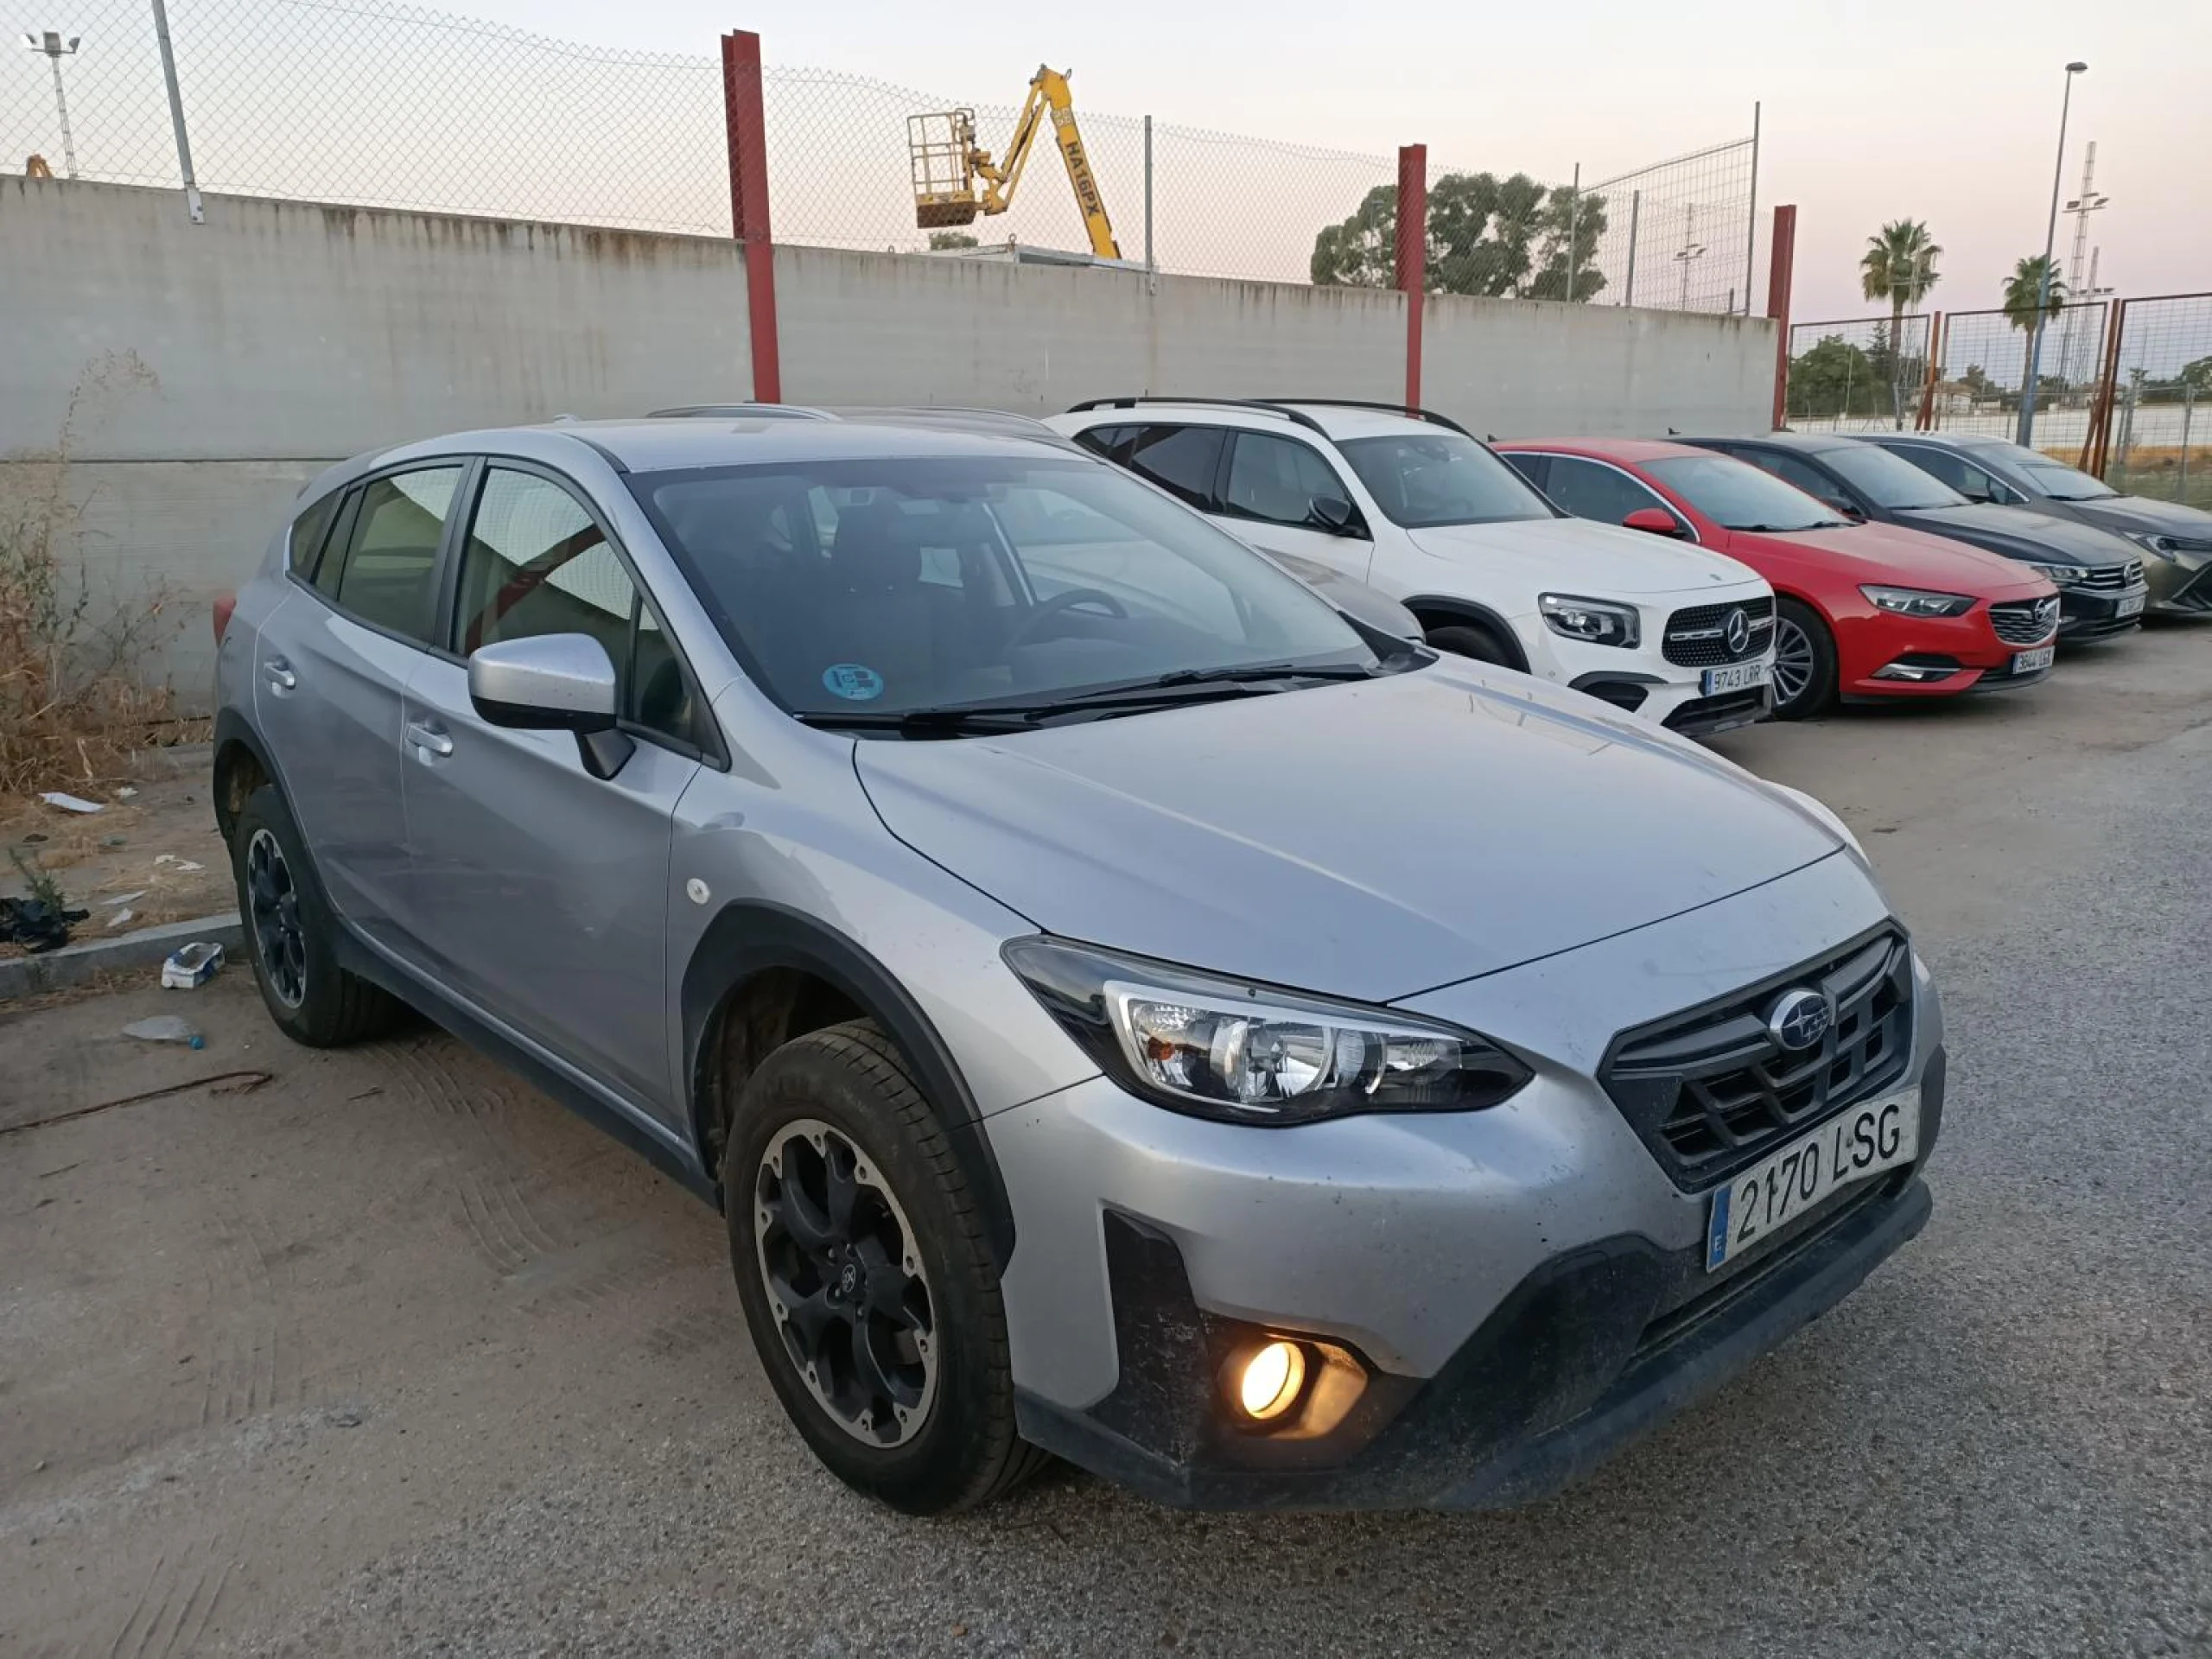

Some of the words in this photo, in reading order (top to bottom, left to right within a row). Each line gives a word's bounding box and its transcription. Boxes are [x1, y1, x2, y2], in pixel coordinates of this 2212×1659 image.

[1066, 142, 1101, 216] HA16PX
[1715, 669, 1740, 690] 9743
[1737, 1142, 1819, 1243] 2170
[1833, 1104, 1899, 1183] LSG
[1714, 1236, 1722, 1251] E
